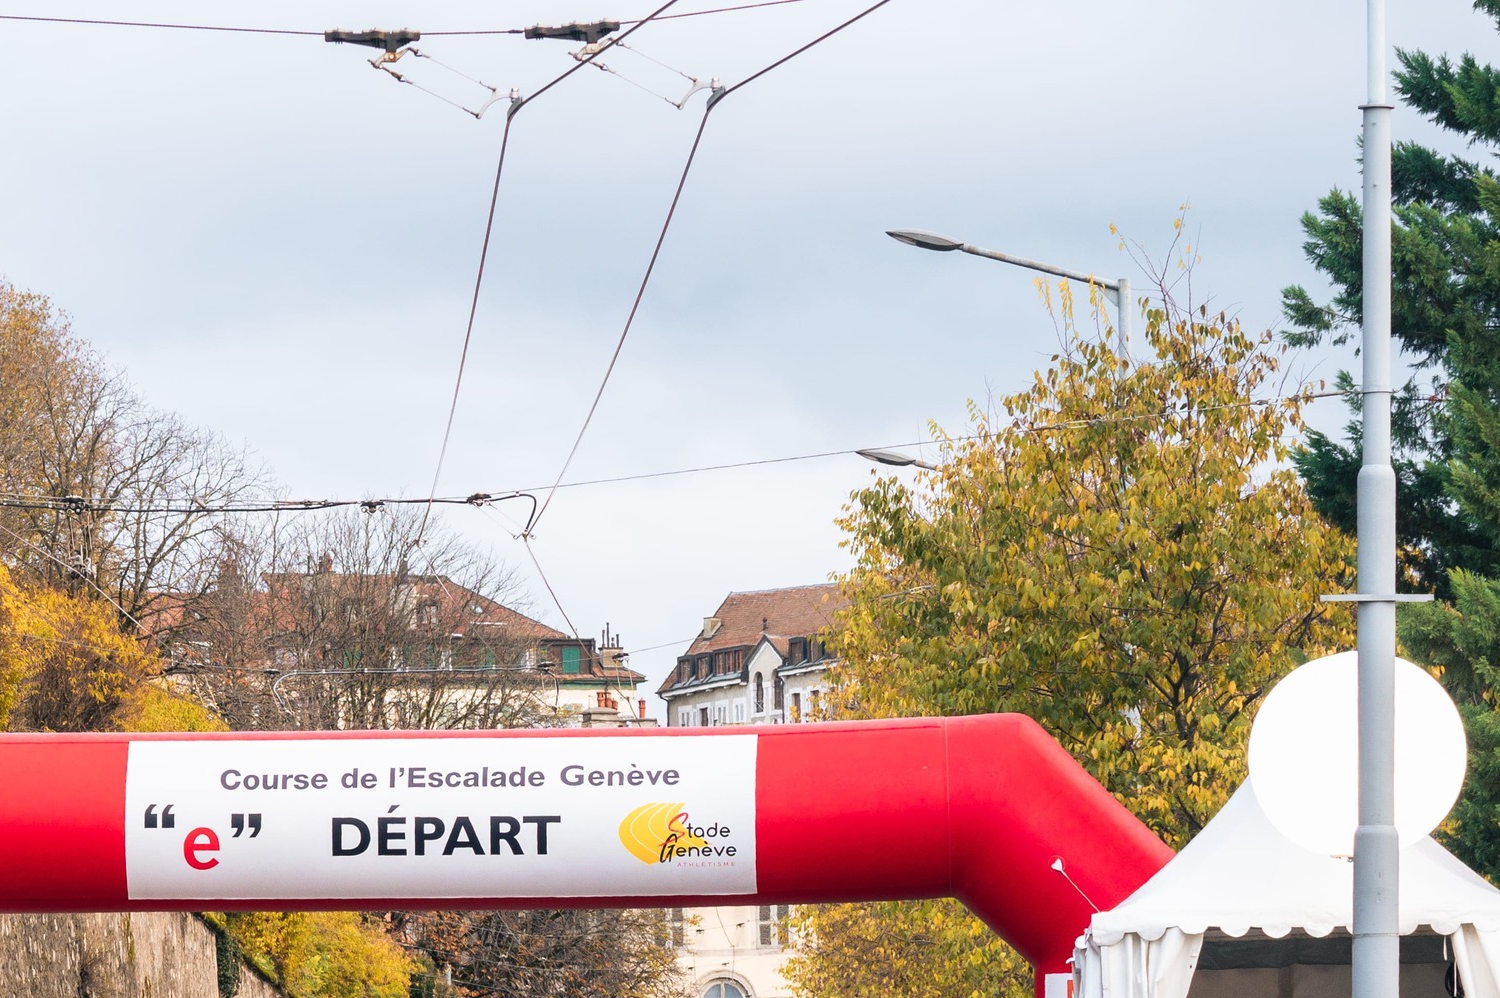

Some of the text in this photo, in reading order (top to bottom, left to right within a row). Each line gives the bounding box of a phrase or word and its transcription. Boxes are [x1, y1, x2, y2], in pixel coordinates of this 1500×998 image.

[219, 769, 328, 790] Course
[340, 767, 378, 789] de
[560, 764, 680, 786] Genève
[331, 805, 561, 857] DÉPART
[658, 812, 731, 847] Stade
[660, 833, 737, 863] Genève
